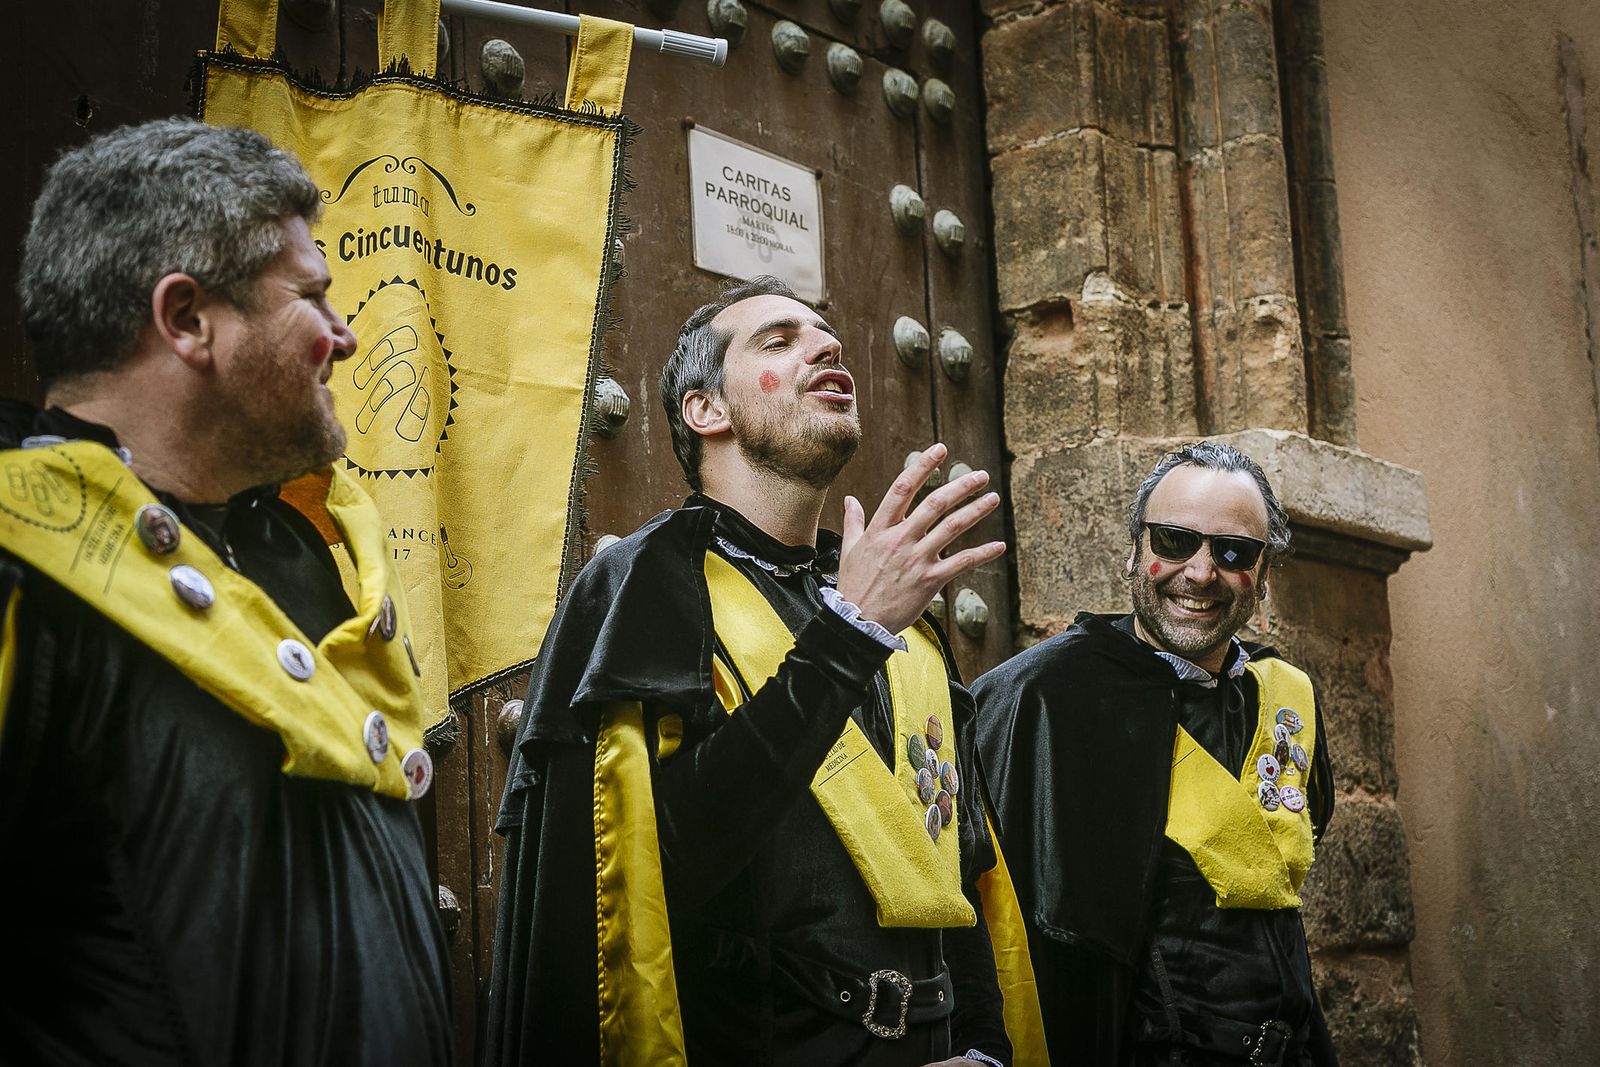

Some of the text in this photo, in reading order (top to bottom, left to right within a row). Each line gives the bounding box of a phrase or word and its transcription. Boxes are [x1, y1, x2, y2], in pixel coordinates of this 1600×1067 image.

[722, 166, 791, 202] CARITAS
[372, 185, 430, 217] tuna
[705, 182, 809, 231] PARROQUIAL
[742, 215, 776, 234] MARTES
[339, 225, 518, 290] Cincuentunos
[387, 528, 437, 546] ANCE
[394, 548, 411, 560] 17
[825, 752, 848, 772] MEDICINA
